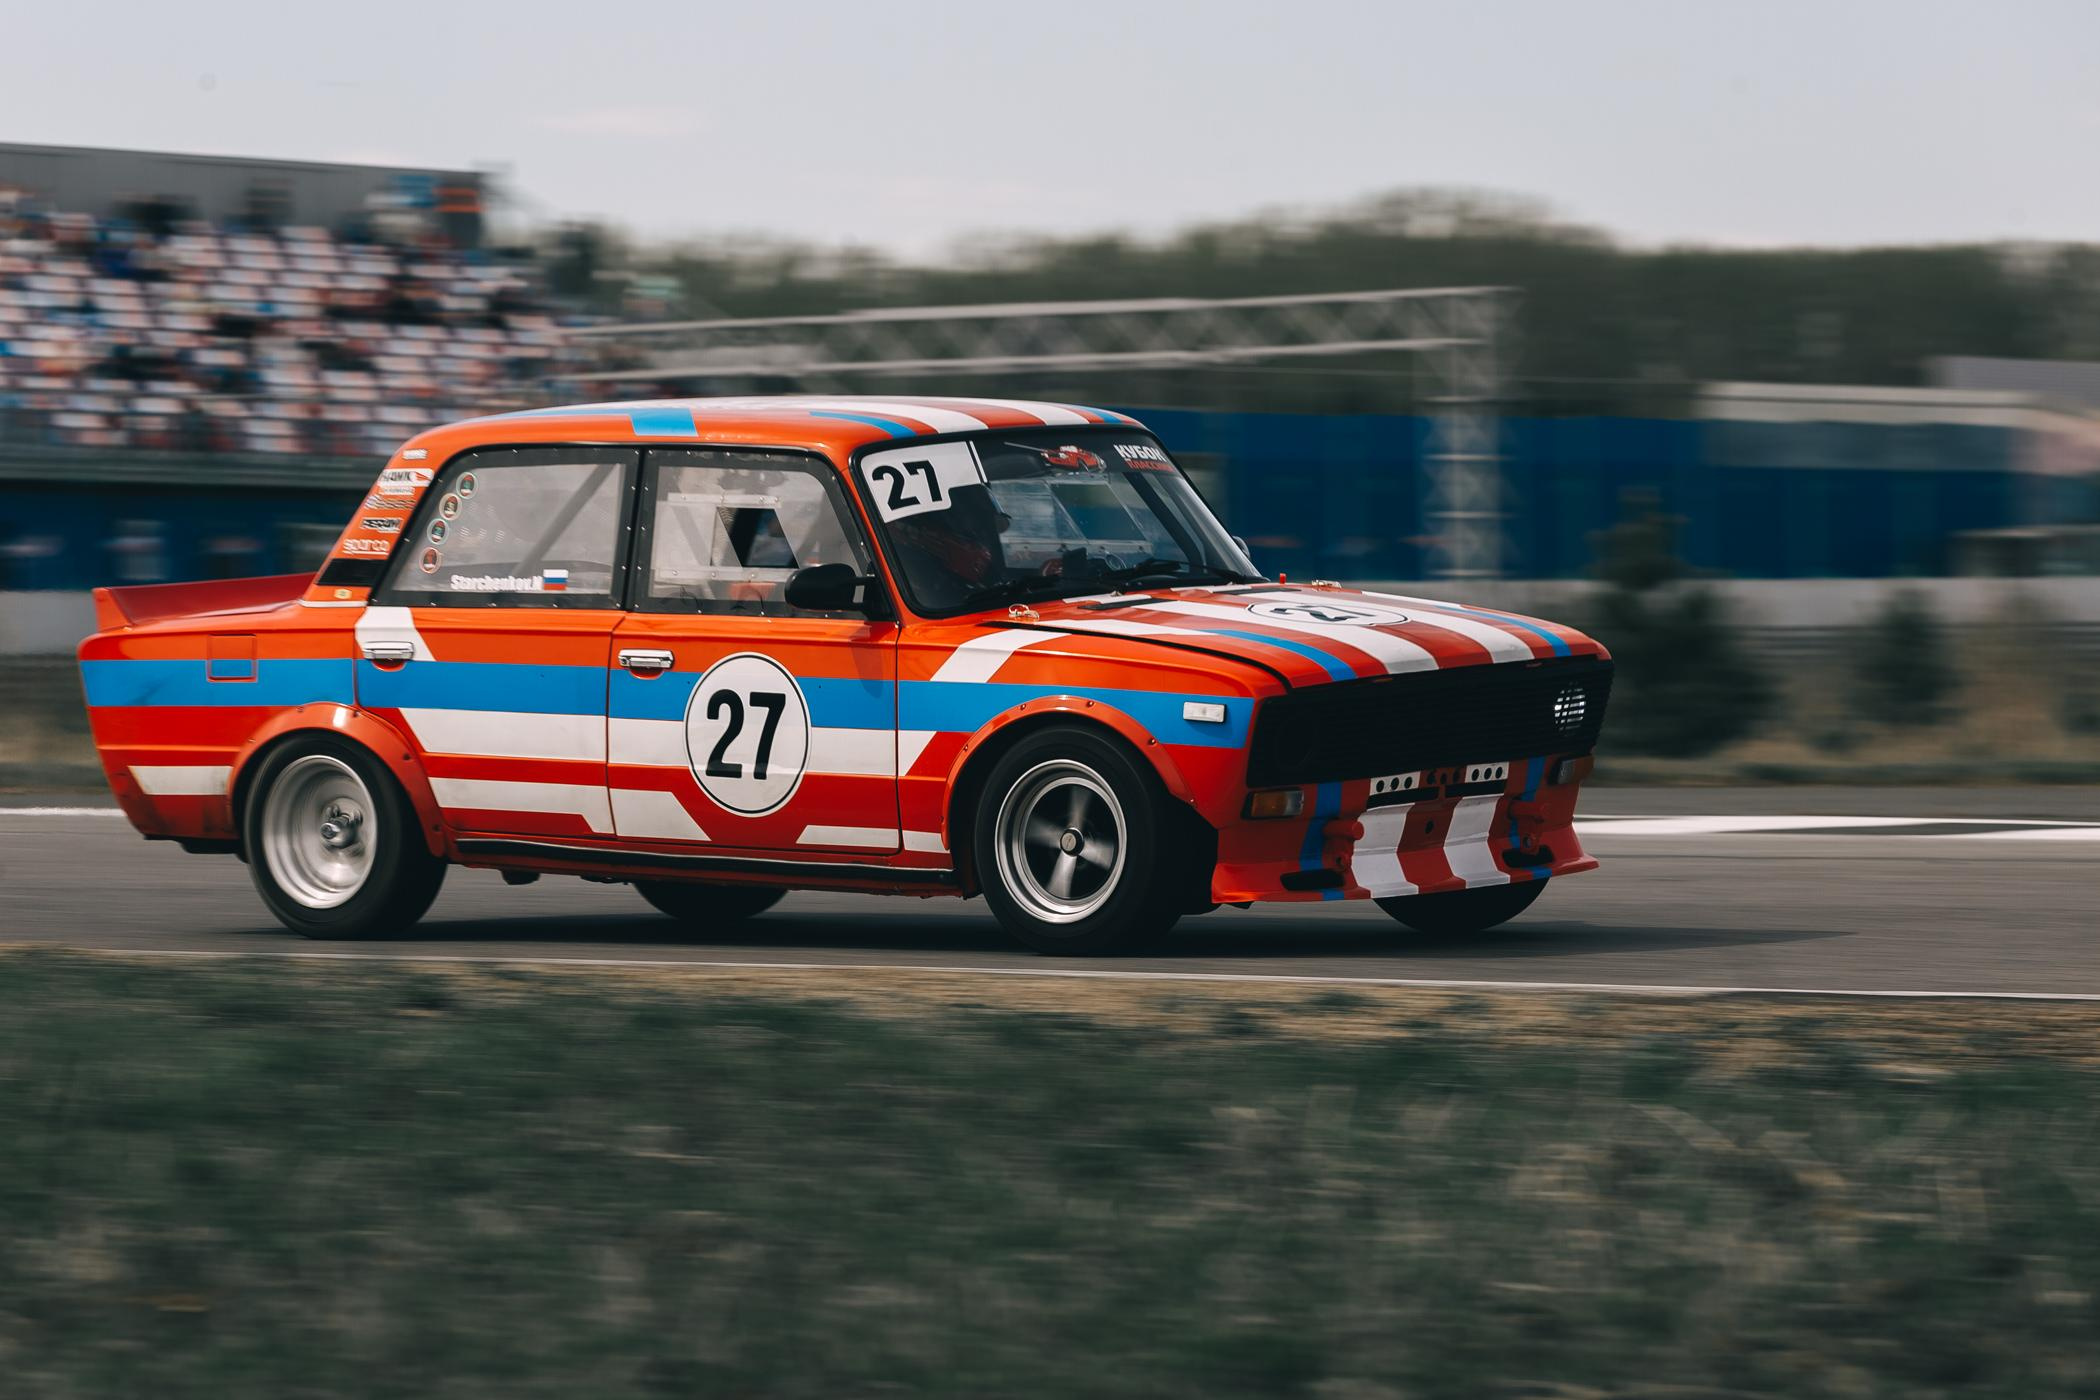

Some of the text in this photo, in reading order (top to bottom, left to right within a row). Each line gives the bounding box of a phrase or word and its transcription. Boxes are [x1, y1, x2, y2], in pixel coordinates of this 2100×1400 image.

[1113, 444, 1167, 463] КУБОК
[871, 459, 943, 511] 27
[705, 689, 787, 780] 27
